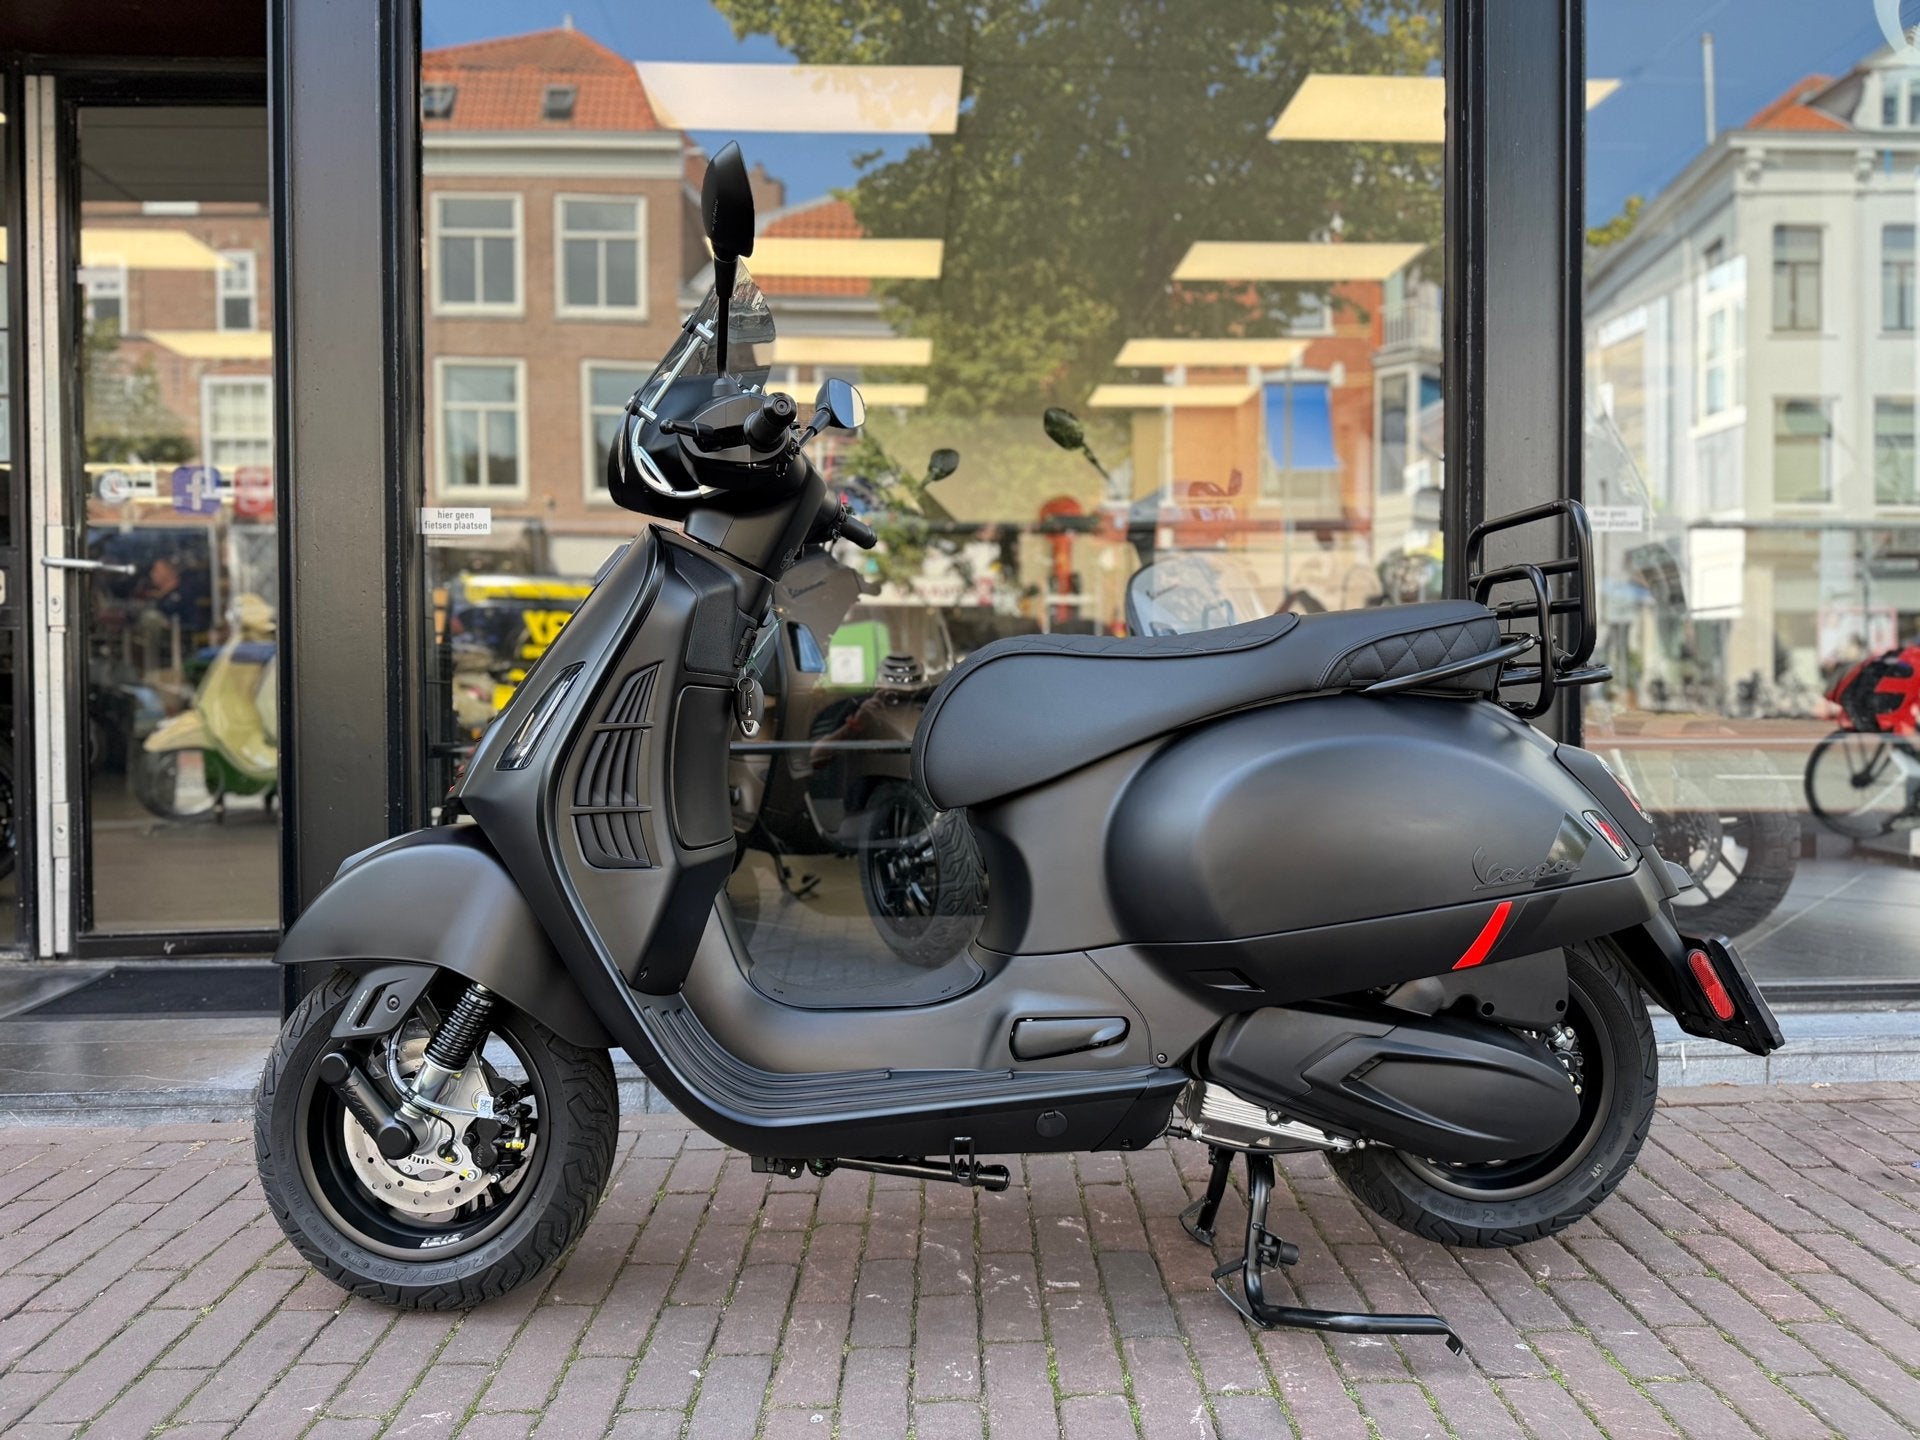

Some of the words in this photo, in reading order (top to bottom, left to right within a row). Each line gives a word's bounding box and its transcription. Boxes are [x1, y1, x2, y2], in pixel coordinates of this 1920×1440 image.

[437, 510, 453, 519] hier
[455, 512, 475, 521] geen
[424, 520, 452, 530] fietsen
[454, 521, 488, 531] plaatsen
[1472, 846, 1581, 891] Vespa
[373, 1263, 420, 1281] CITY
[423, 1262, 471, 1281] GRIP
